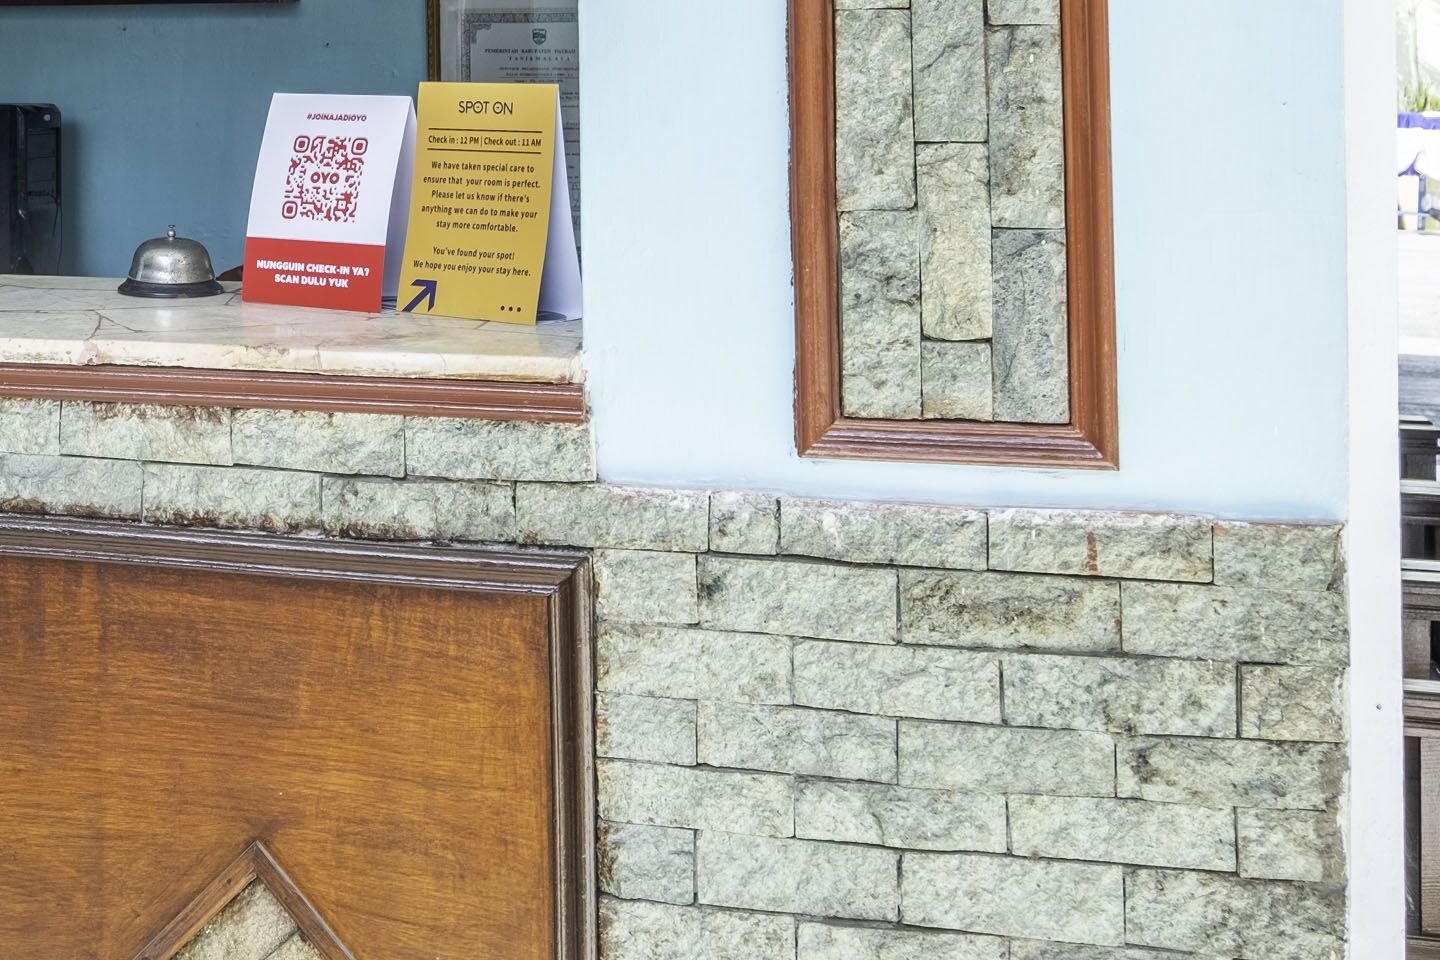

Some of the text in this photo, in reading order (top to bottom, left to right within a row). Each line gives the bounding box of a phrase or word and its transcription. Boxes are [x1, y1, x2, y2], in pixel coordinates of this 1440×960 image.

[458, 101, 513, 115] SPOT ON
[307, 113, 367, 122] #JOINAJADIOYO
[428, 135, 447, 144] Check
[449, 136, 455, 144] in
[469, 137, 479, 145] PM
[484, 138, 504, 146] Check
[531, 139, 541, 147] AM
[431, 161, 534, 173] We have taken special care to
[310, 172, 340, 184] OYO
[423, 176, 446, 184] ensure
[448, 176, 462, 184] that
[466, 178, 482, 187] your
[504, 177, 510, 187] is
[512, 178, 540, 188] perfect.
[431, 190, 453, 199] Please
[455, 190, 465, 199] let
[476, 191, 495, 201] know
[497, 192, 503, 201] if
[504, 193, 530, 203] there's
[421, 205, 452, 216] anything
[479, 207, 488, 216] do
[490, 208, 498, 216] to
[499, 209, 519, 217] make
[521, 211, 538, 220] your
[436, 220, 518, 232] stay more comfortable.
[433, 246, 515, 261] You've found your spot!
[256, 259, 369, 277] NUNGGUIN CHECK-IN YA?
[413, 260, 531, 276] We hope you enjoy your stay here.
[274, 274, 348, 288] SCAN DULU YUK
